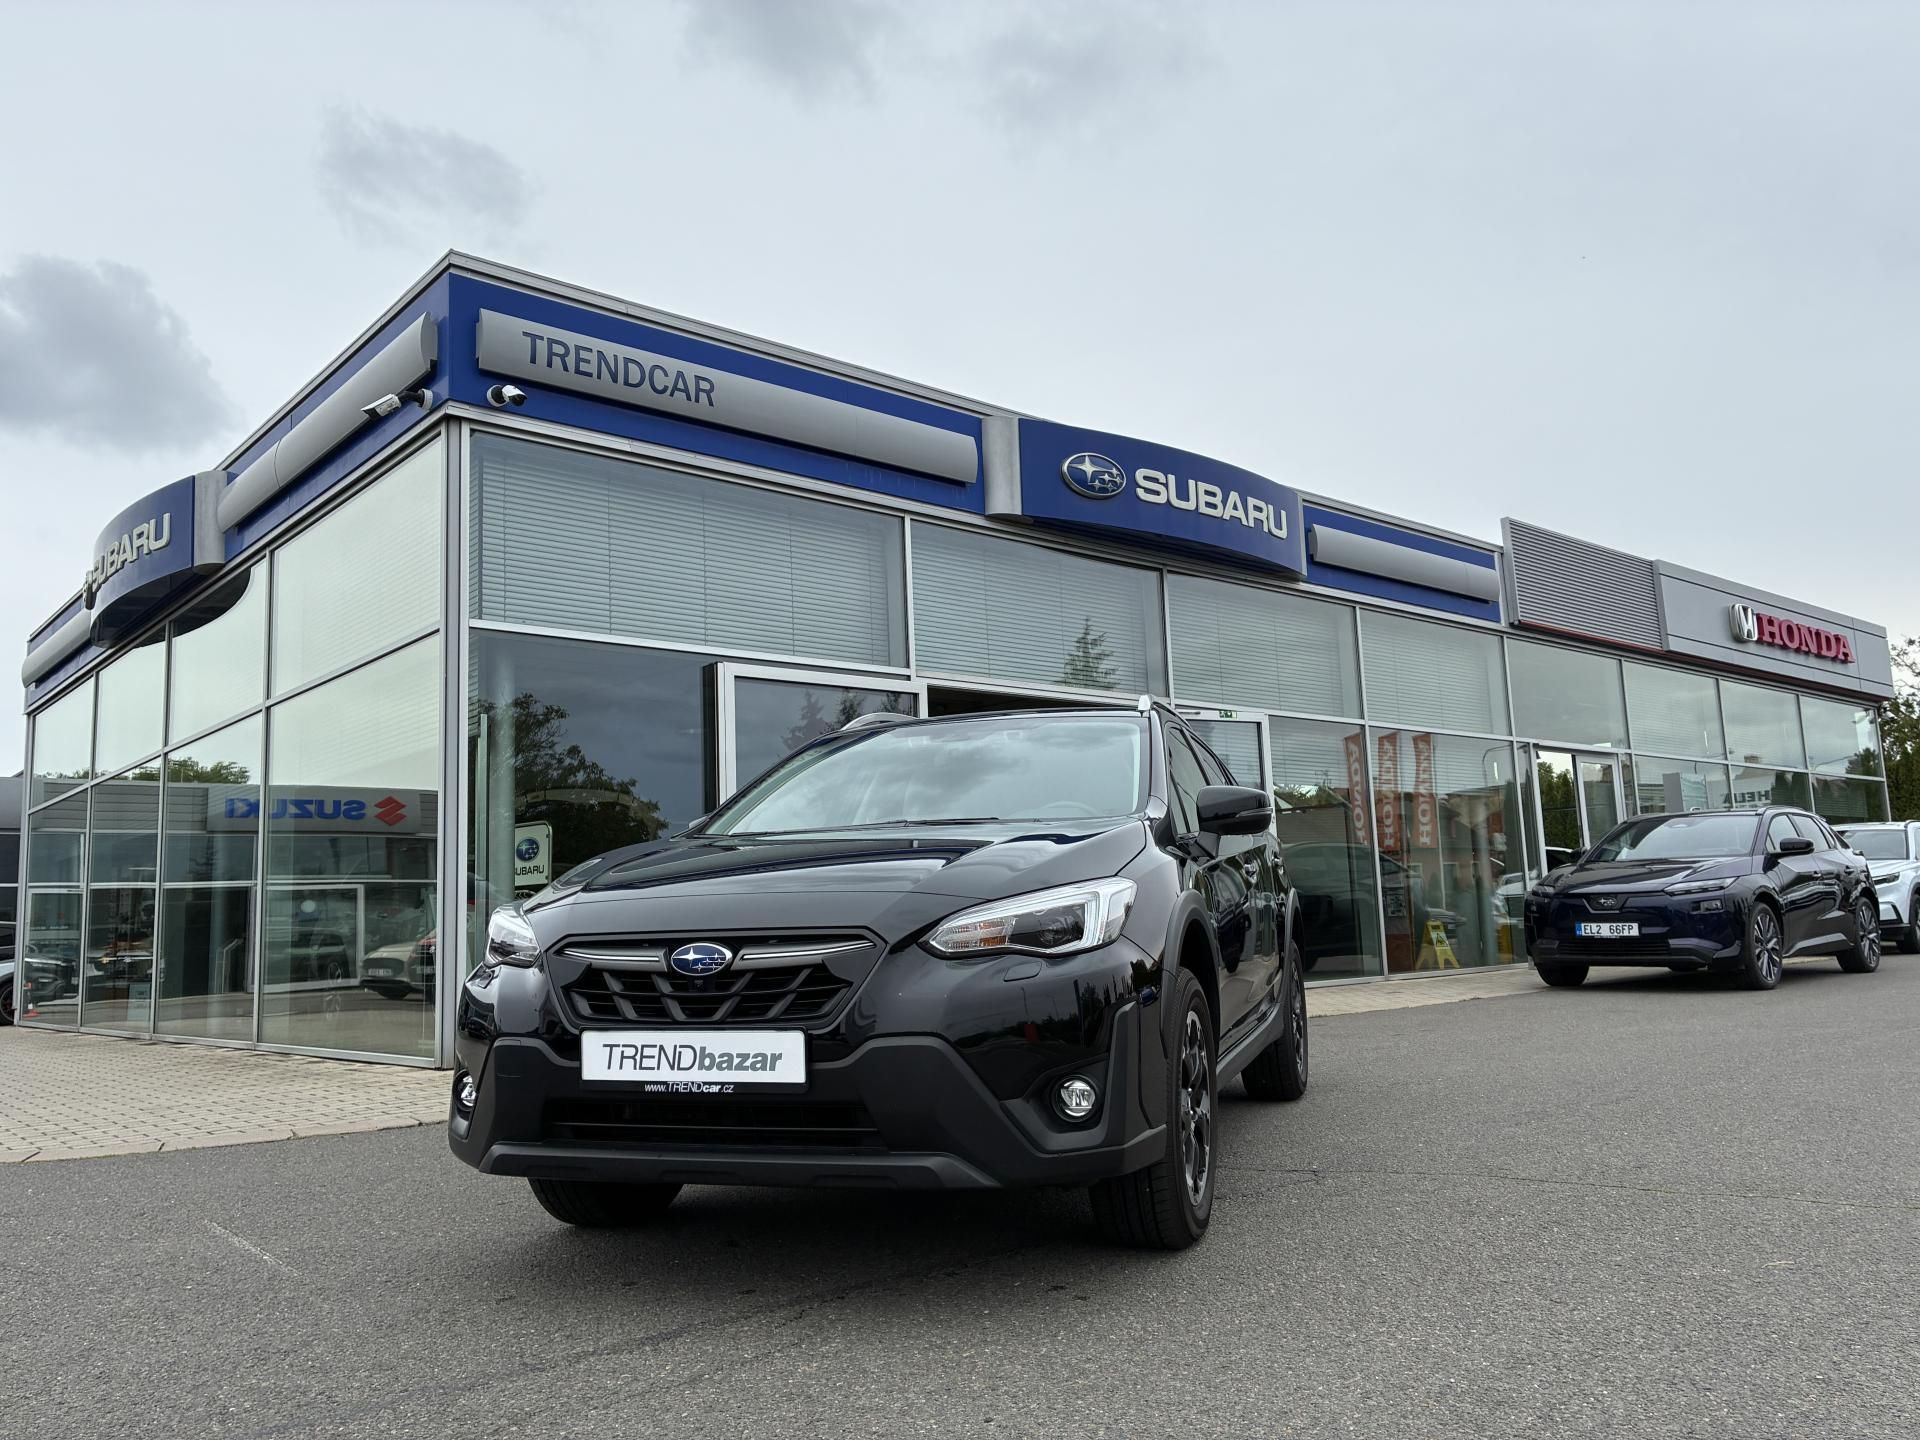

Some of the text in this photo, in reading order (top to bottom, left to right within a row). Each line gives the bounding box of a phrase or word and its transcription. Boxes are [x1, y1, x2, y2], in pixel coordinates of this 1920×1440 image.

[522, 331, 715, 408] TRENDCAR
[1134, 468, 1288, 540] SUBARU
[91, 512, 171, 593] SUBARU
[1756, 612, 1856, 664] HONDA
[515, 864, 545, 876] UBARU
[1583, 924, 1634, 935] EL2 66FP
[602, 1043, 783, 1072] TRENDbazar
[644, 1081, 735, 1093] www.TRENDcar.cz
